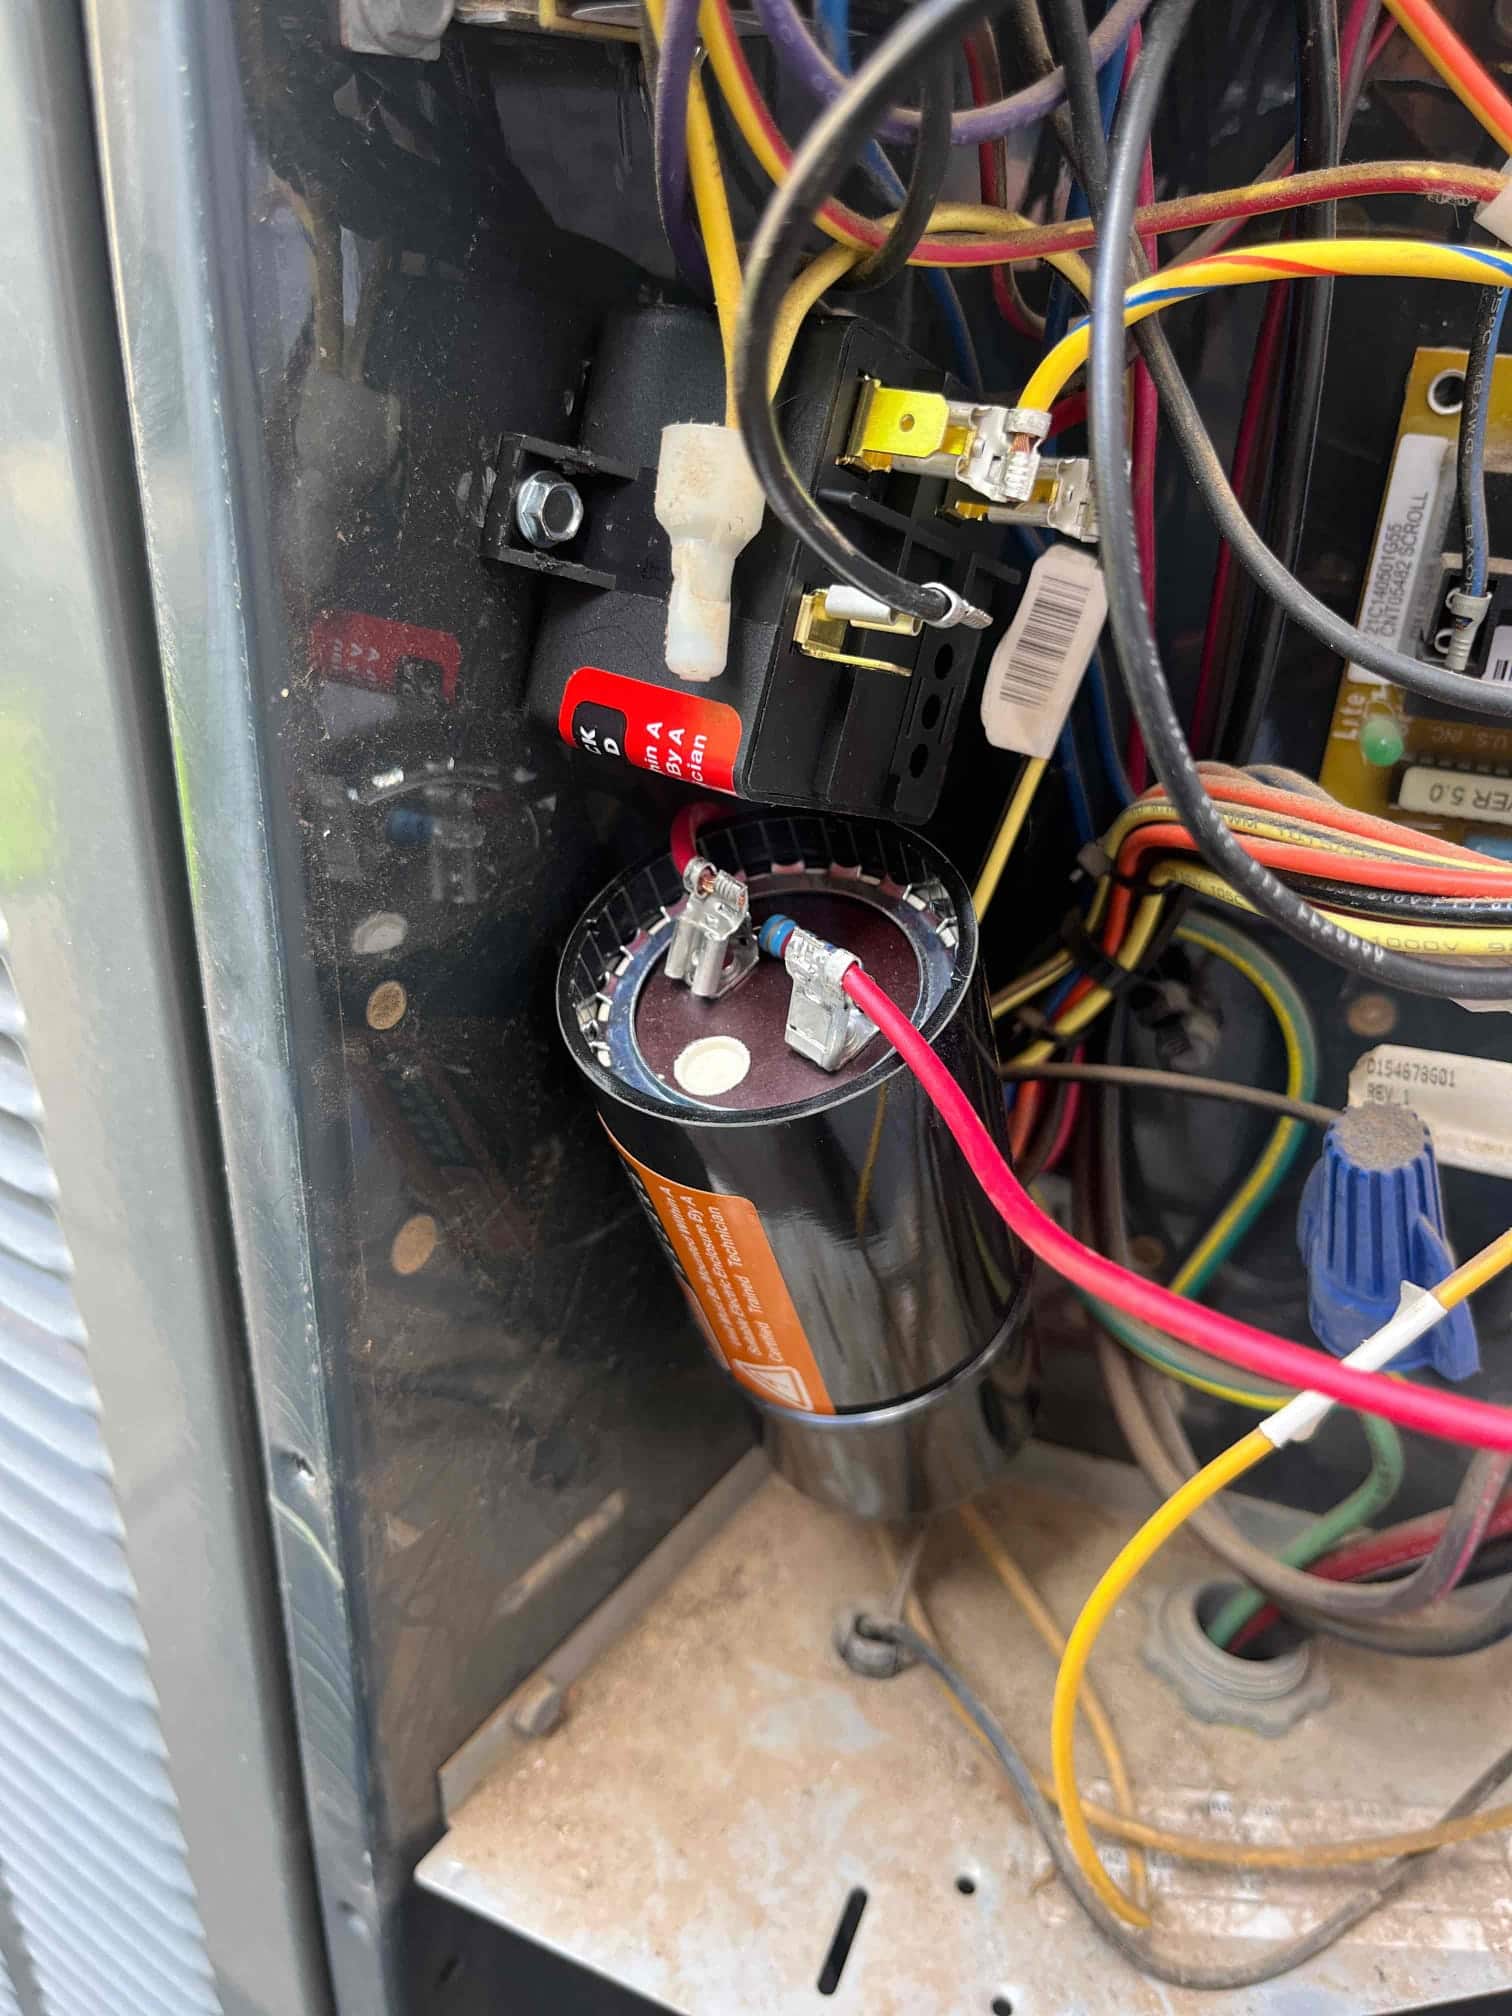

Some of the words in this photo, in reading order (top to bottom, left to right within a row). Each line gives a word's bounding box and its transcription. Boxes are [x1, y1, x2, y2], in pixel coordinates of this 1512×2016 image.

[1400, 490, 1429, 558] SCROLL
[646, 721, 664, 739] A
[668, 727, 686, 747] A
[666, 749, 683, 777] By
[1429, 782, 1465, 806] 5.0
[707, 1205, 744, 1268] Technician
